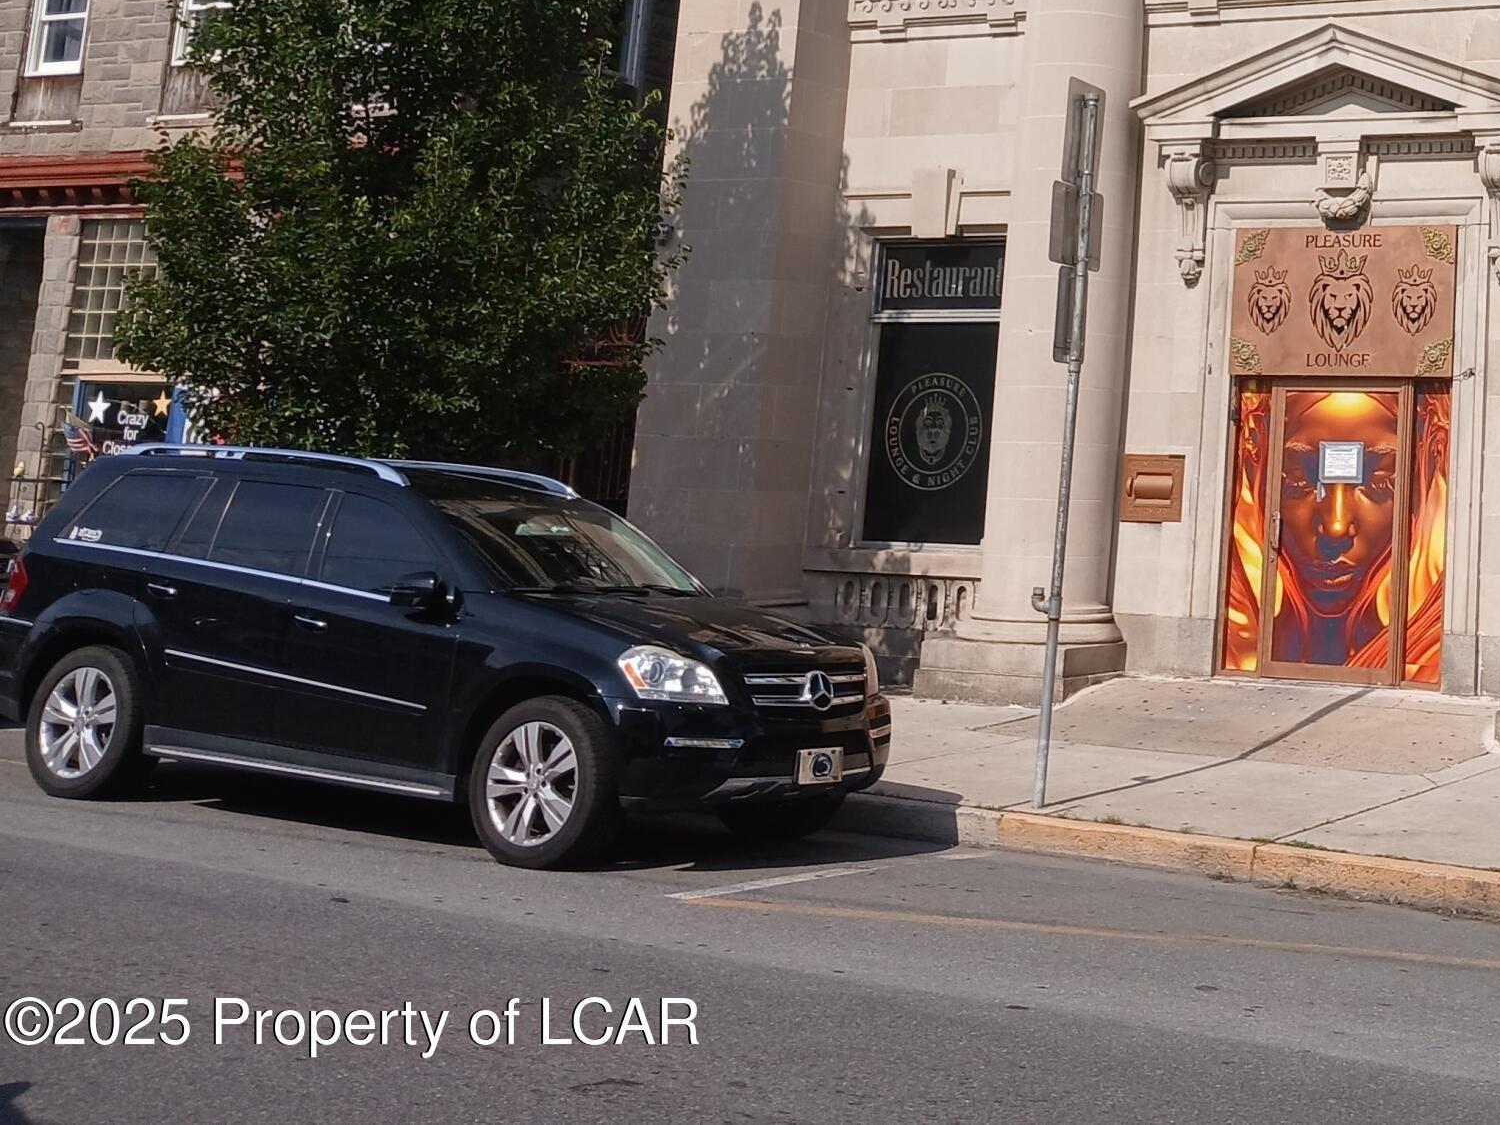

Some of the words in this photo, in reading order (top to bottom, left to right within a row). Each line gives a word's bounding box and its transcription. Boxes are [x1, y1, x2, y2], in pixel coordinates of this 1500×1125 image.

[1305, 234, 1382, 248] PLEASURE
[885, 258, 1002, 298] Restaurant
[1305, 353, 1371, 368] LOUNGE
[911, 377, 967, 397] PLEASURE
[117, 410, 149, 429] Crazy
[123, 426, 139, 440] for
[889, 416, 909, 474] LOUNGE
[927, 459, 966, 486] NIGHT
[965, 416, 979, 455] CLUB
